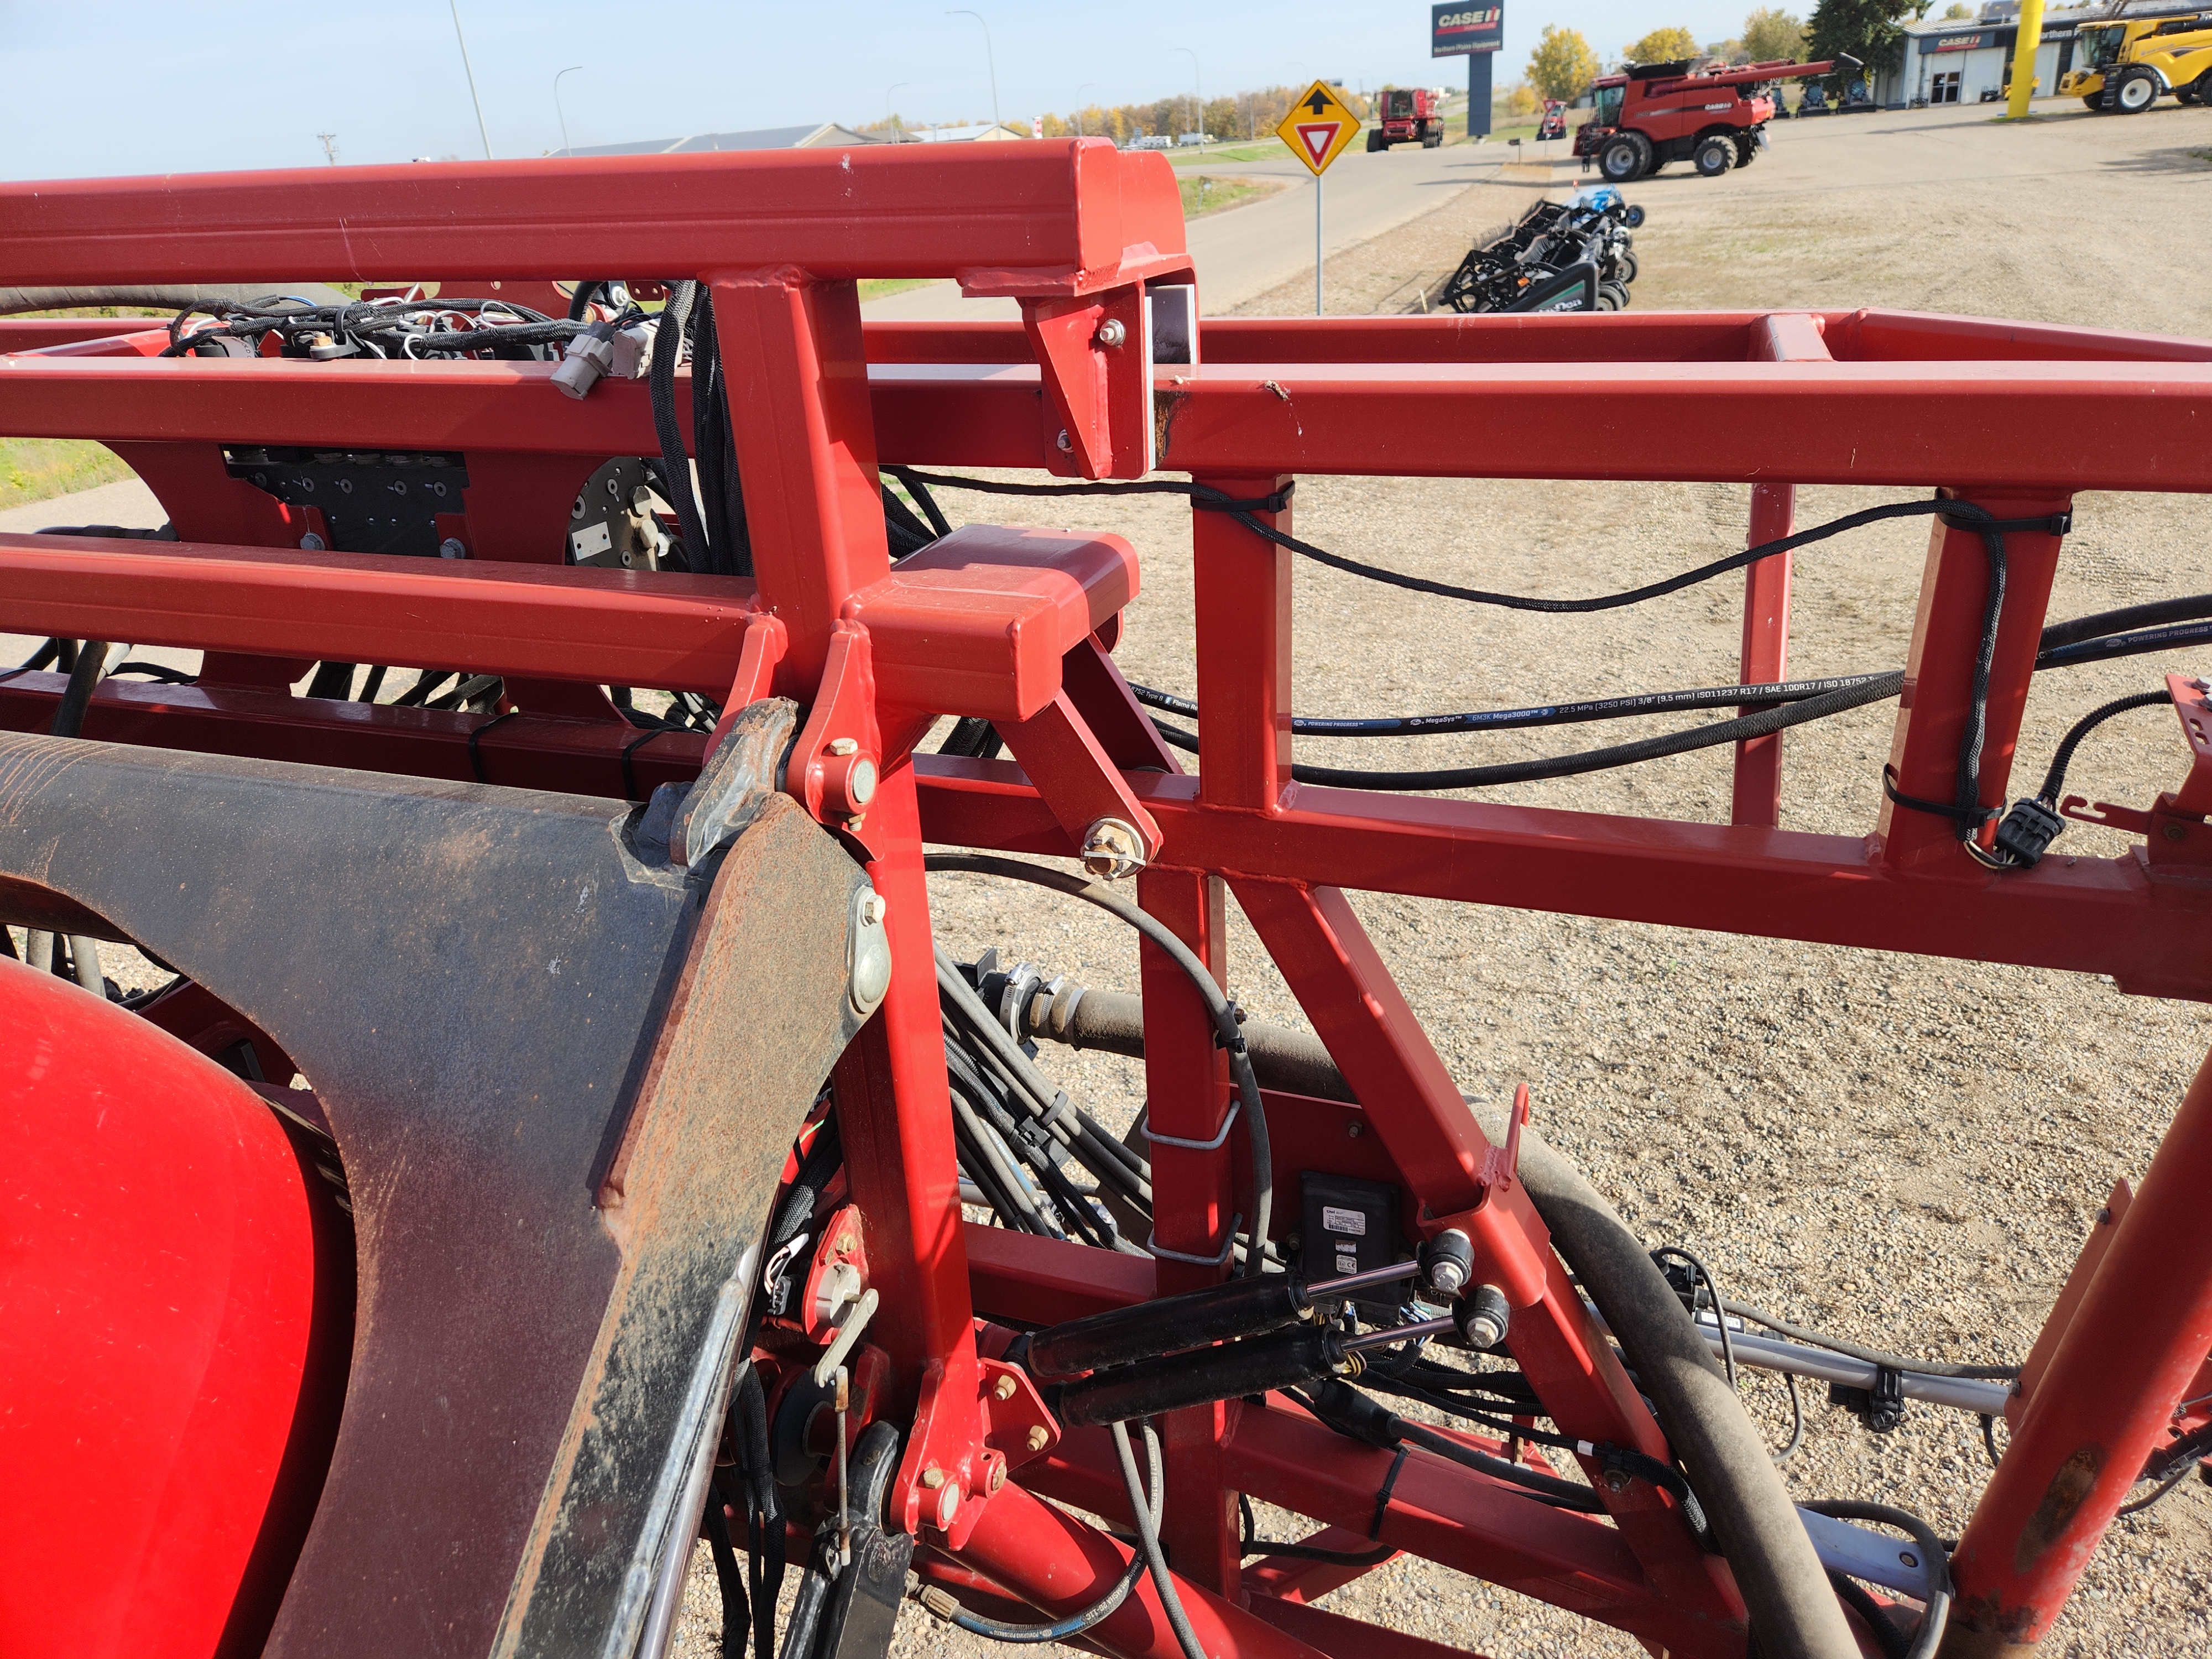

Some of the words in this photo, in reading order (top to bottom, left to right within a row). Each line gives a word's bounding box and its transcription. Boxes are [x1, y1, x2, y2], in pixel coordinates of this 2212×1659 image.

[1438, 11, 1485, 27] CASE
[1938, 36, 1970, 46] CASE
[2039, 29, 2073, 39] orthern
[2128, 632, 2167, 643] POWERING
[1146, 691, 1158, 700] Type
[1172, 699, 1190, 709] Flame
[1637, 696, 1655, 705] 3/8"
[1697, 688, 1738, 699] ISO11237
[1765, 685, 1781, 693] SAE
[1783, 682, 1815, 691] 100R17
[1824, 680, 1838, 688] ISO
[1121, 1561, 1141, 1589] Resistant
[1106, 1589, 1123, 1604] MSHA
